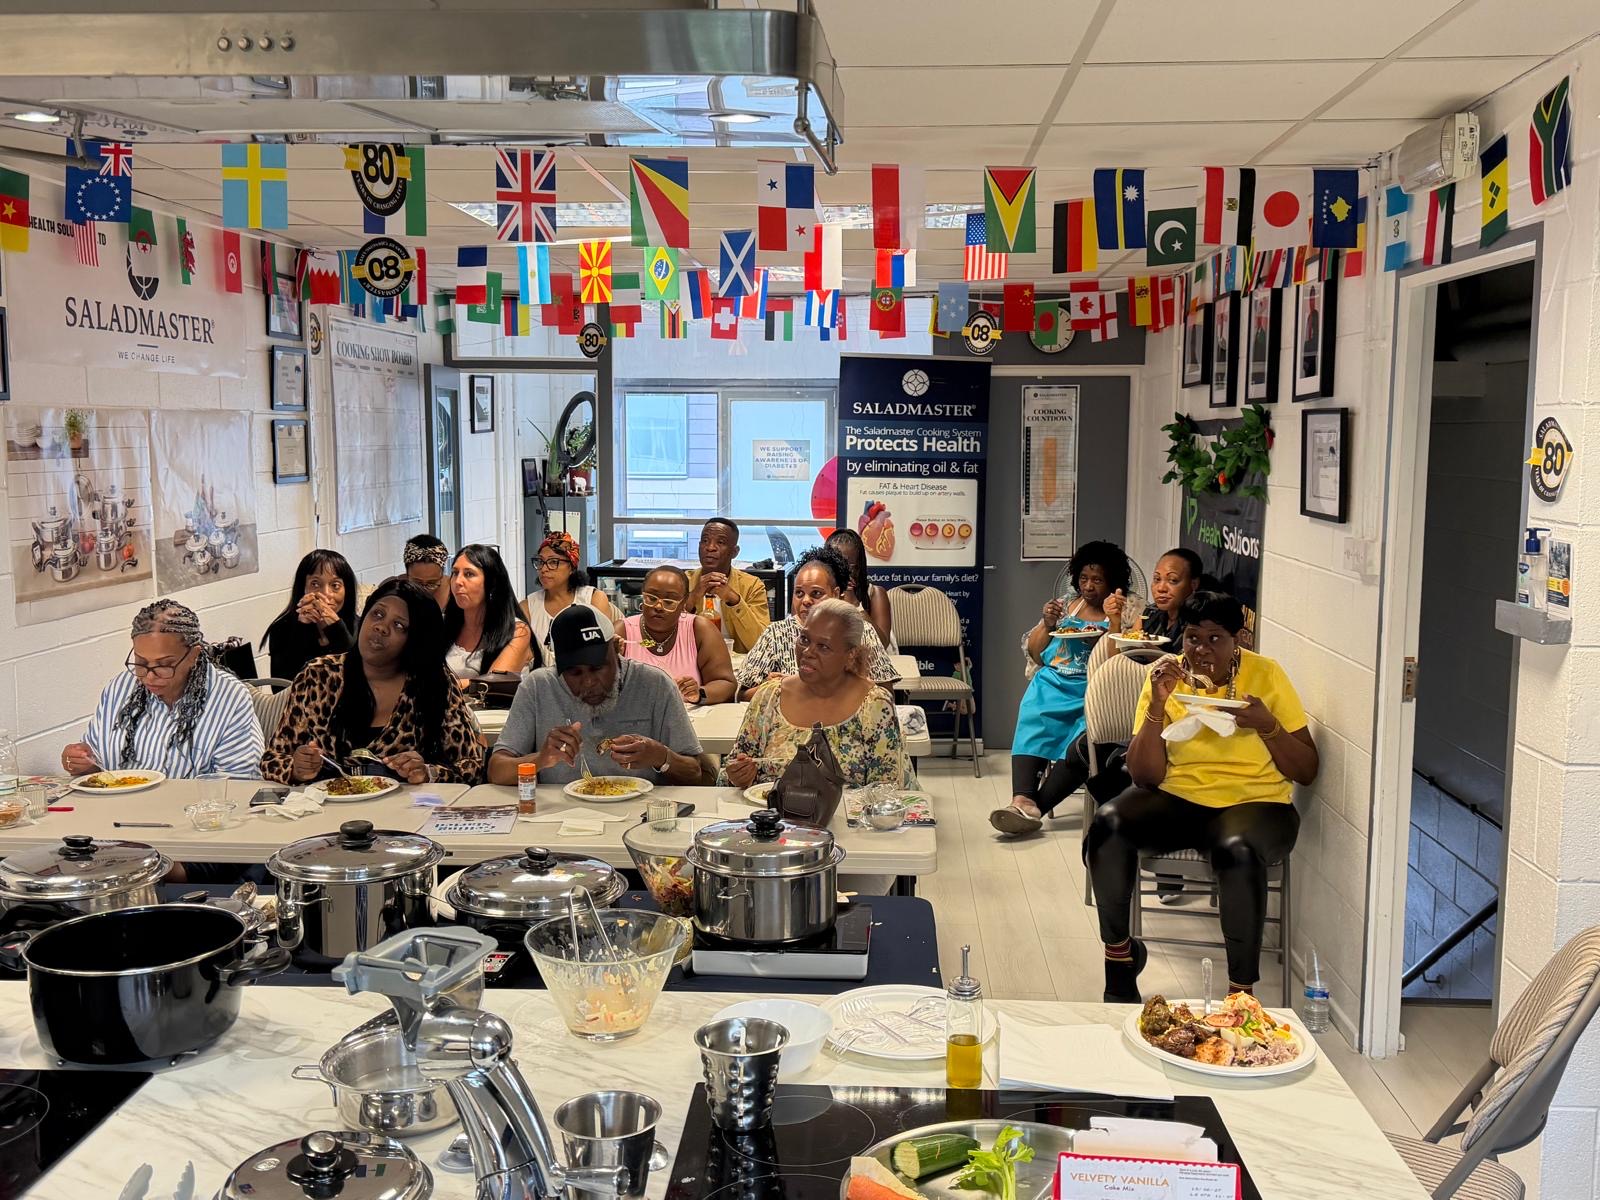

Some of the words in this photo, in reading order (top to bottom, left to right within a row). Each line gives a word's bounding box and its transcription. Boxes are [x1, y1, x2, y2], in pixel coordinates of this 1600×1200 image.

[363, 144, 394, 185] 80
[28, 215, 55, 234] HEALTH
[57, 222, 74, 237] SOLU
[97, 232, 107, 245] TD
[584, 333, 599, 348] 80
[118, 351, 128, 359] WE
[132, 352, 159, 362] CHANGE
[162, 355, 175, 363] LIFE
[337, 341, 370, 360] COOKING
[371, 346, 390, 363] SHOW
[846, 426, 861, 435] The
[864, 426, 914, 436] Saladmaster
[917, 428, 950, 438] Cooking
[952, 428, 981, 438] System
[845, 435, 918, 452] Protects
[923, 436, 980, 453] Health
[1543, 441, 1565, 476] 80
[847, 459, 862, 474] by
[865, 460, 930, 475] eliminating
[933, 461, 946, 473] oil
[950, 461, 960, 473] &
[963, 461, 979, 473] fat
[867, 574, 889, 582] educe
[891, 574, 901, 582] fat
[903, 574, 910, 582] in
[912, 575, 929, 583] your
[931, 573, 960, 583] family's
[961, 574, 979, 582] diet?
[963, 590, 970, 598] by
[582, 630, 601, 641] UA
[918, 660, 935, 671] ible
[1070, 1171, 1117, 1183] VELVETY
[1120, 1174, 1169, 1187] VANILLA
